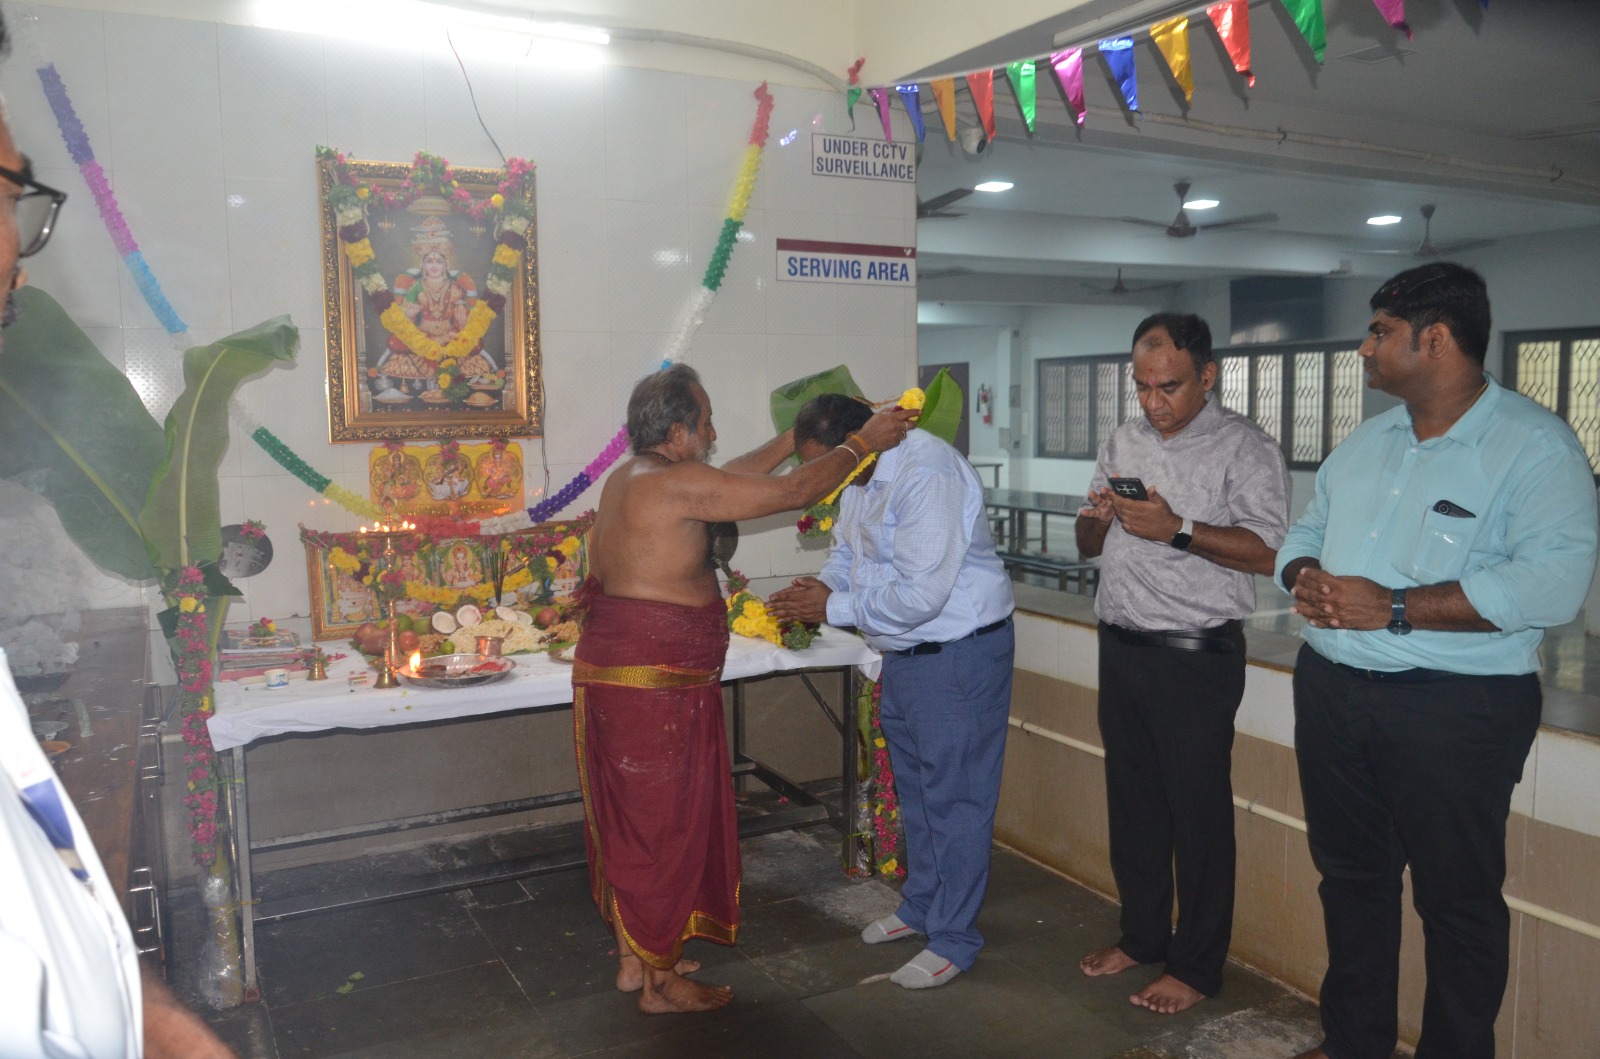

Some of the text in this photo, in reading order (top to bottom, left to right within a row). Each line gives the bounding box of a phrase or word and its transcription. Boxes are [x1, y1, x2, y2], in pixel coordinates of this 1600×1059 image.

[823, 138, 907, 160] UNDER CCTV
[816, 157, 913, 180] SURVEILLANCE
[787, 256, 910, 282] SERVING AREA
